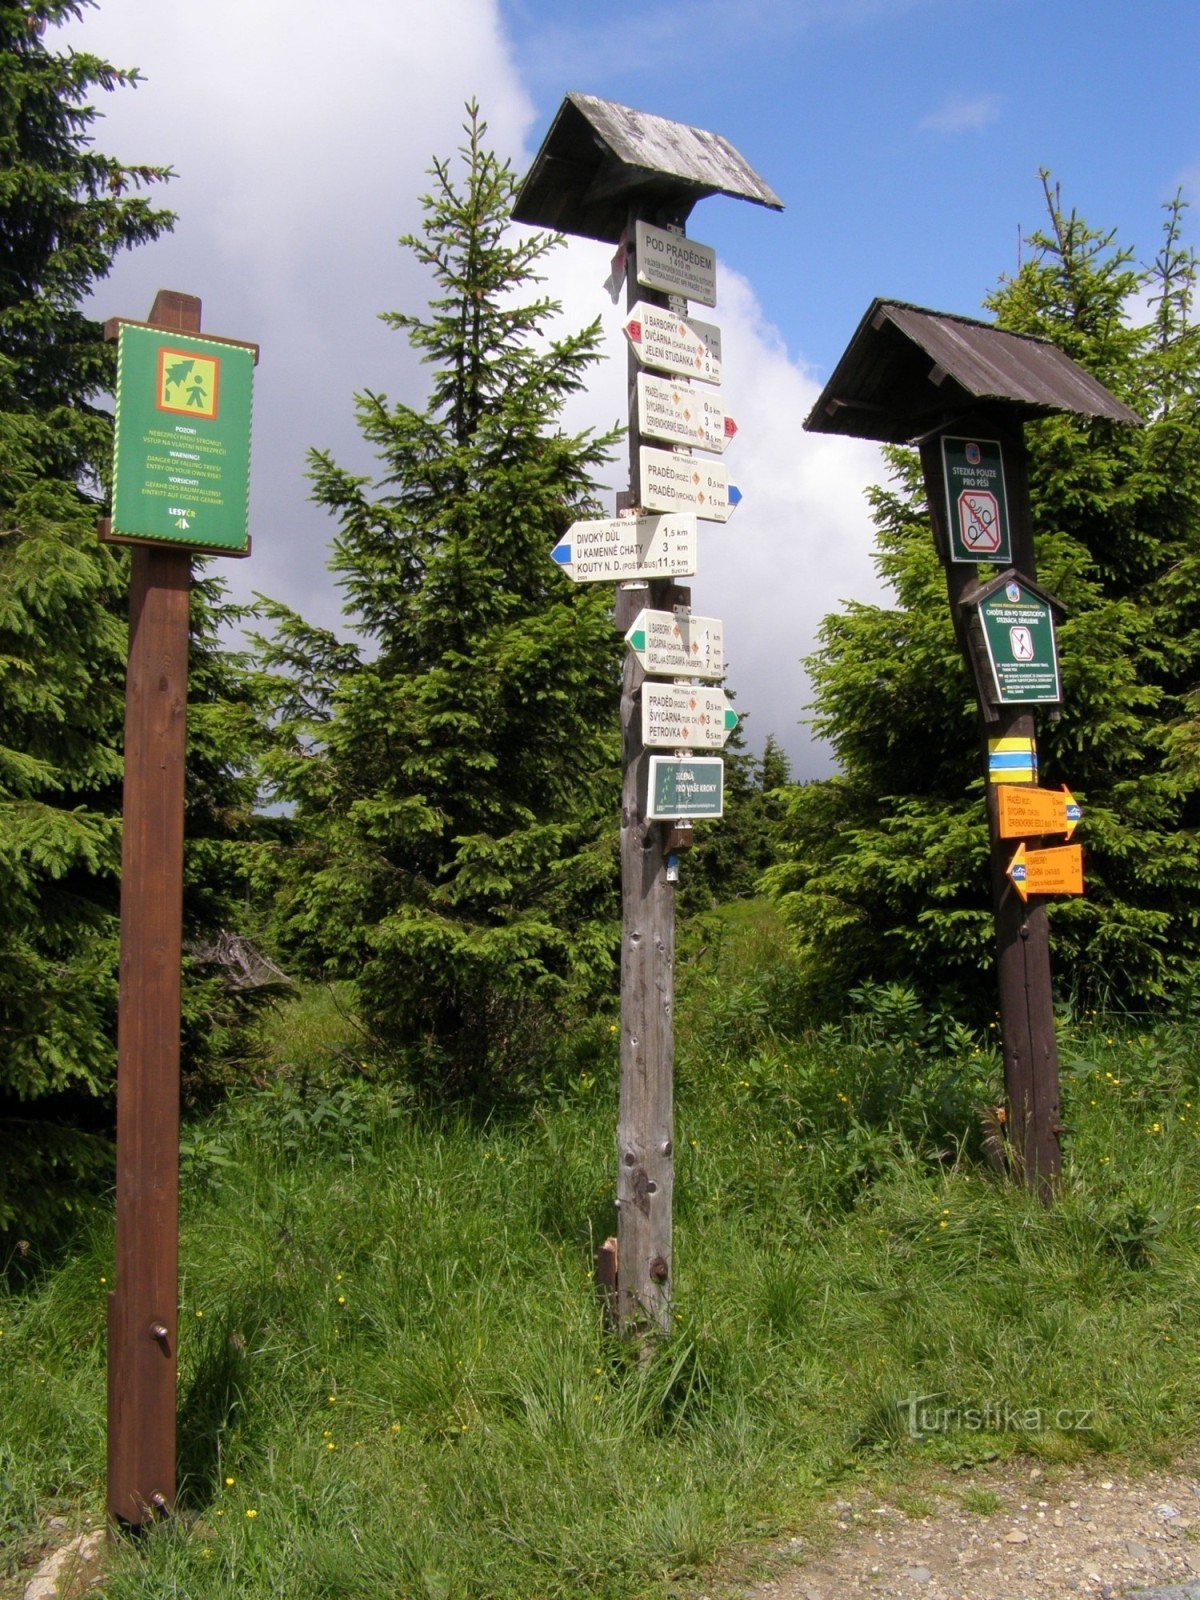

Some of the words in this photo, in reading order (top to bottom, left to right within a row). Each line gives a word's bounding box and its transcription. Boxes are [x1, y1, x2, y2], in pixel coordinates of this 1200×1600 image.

[646, 235, 664, 251] POD
[667, 243, 711, 270] PRADĚDEM
[674, 259, 684, 269] 410
[644, 314, 648, 324] U
[650, 316, 677, 333] BARBORKY
[631, 324, 640, 336] E3
[645, 327, 671, 345] OVČÁRNA
[706, 348, 709, 357] 2
[646, 345, 664, 358] JELENÍ
[665, 350, 693, 367] STUDÁNKA
[706, 363, 709, 371] 8
[704, 402, 712, 412] 0,5
[704, 417, 708, 426] 3
[175, 426, 197, 435] POZOR!
[705, 431, 714, 443] 9,5
[726, 422, 735, 432] E3
[172, 440, 194, 450] VLASTNÍ
[169, 451, 200, 461] WARNING!
[147, 455, 171, 464] DANGER
[180, 460, 202, 469] FALLING
[648, 465, 675, 480] PRADĚD
[708, 477, 716, 486] 0,5
[952, 467, 975, 476] STEZKA
[976, 469, 996, 478] POUZE
[168, 476, 199, 486] VORSICHT!
[977, 478, 989, 487] PĚŠÍ
[145, 481, 168, 489] GEFAHR
[180, 485, 221, 497] BAUMFALLENS!
[142, 489, 166, 497] EINTRITT
[180, 493, 199, 501] EIGENE
[200, 496, 224, 505] GEFAHR!
[649, 484, 676, 498] PRADĚD
[709, 496, 717, 506] 1,5
[577, 530, 604, 544] DIVOKÝ
[606, 531, 620, 541] DŮL
[663, 527, 675, 538] 1,5
[577, 549, 582, 558] U
[584, 544, 618, 558] KAMENNÉ
[620, 544, 643, 555] CHATY
[663, 543, 668, 552] 3
[578, 563, 602, 574] KOUTY
[604, 562, 613, 571] N.
[614, 561, 621, 570] D.
[658, 558, 675, 568] 11,5
[706, 630, 709, 639] 1
[706, 645, 710, 654] 2
[706, 660, 710, 668] 7
[649, 695, 673, 707] PRADĚD
[706, 715, 710, 724] 3
[649, 726, 680, 737] PETROVKA
[676, 784, 685, 792] PRO
[686, 783, 699, 792] VAŠE
[700, 784, 716, 792] KROKY
